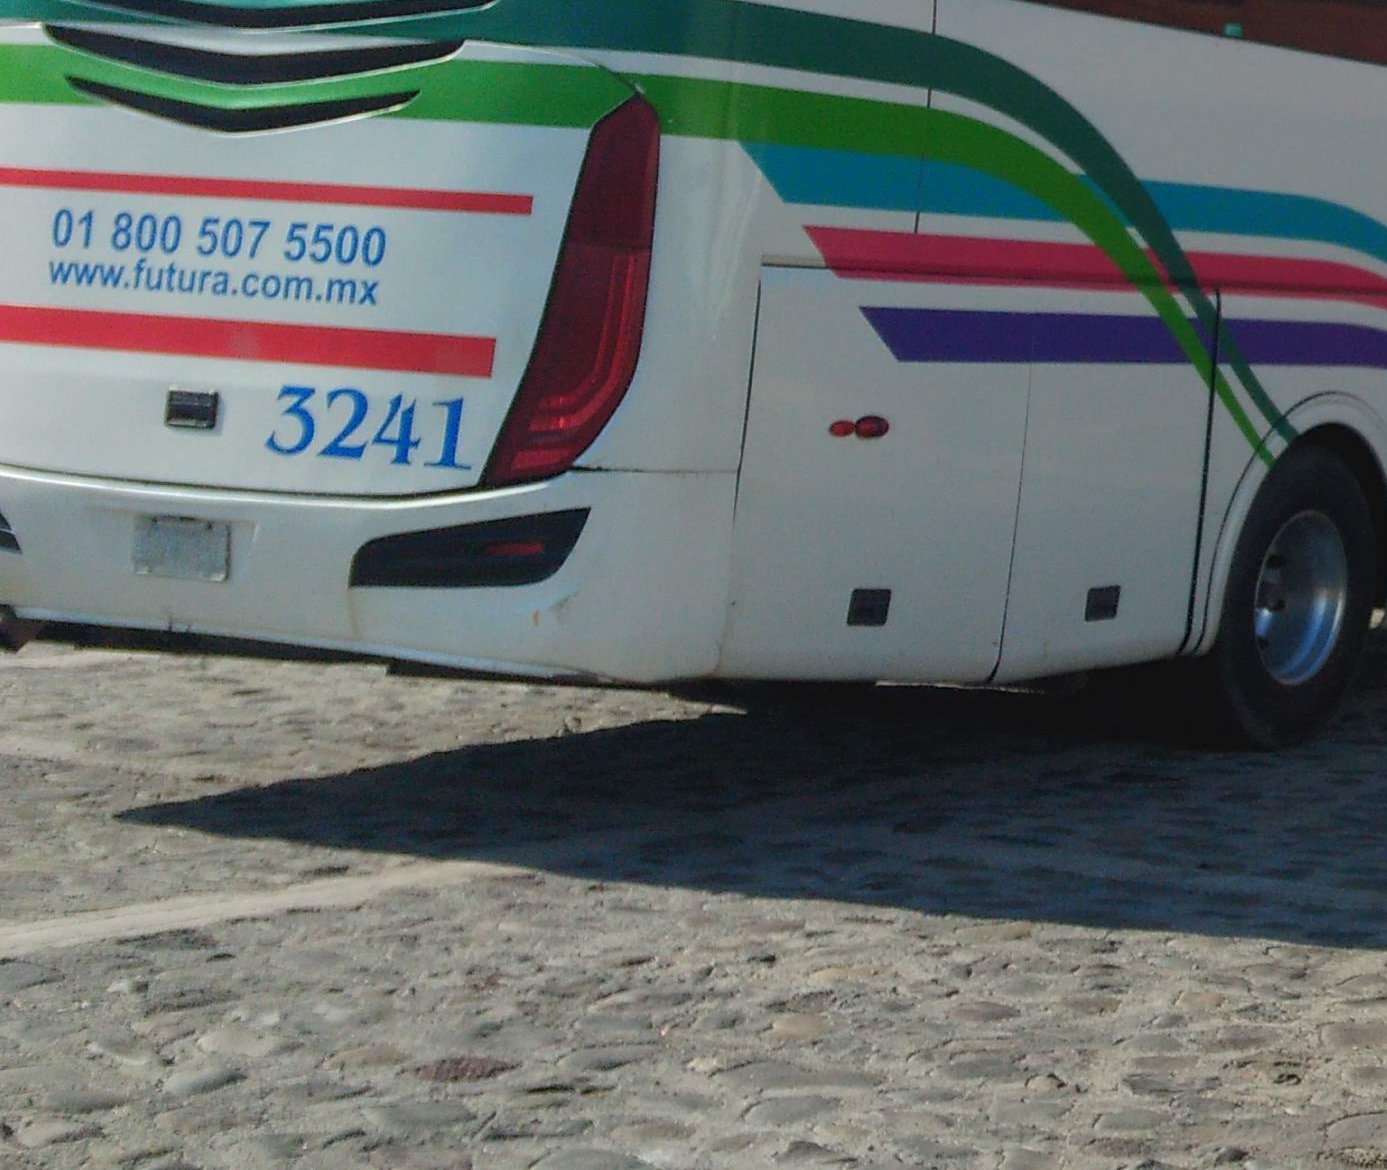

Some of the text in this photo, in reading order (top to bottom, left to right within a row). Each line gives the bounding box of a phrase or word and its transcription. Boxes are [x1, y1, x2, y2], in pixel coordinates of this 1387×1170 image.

[52, 209, 387, 268] 01 800 507 5500
[49, 257, 380, 306] www.futura.com.mx
[264, 385, 472, 471] 3241
